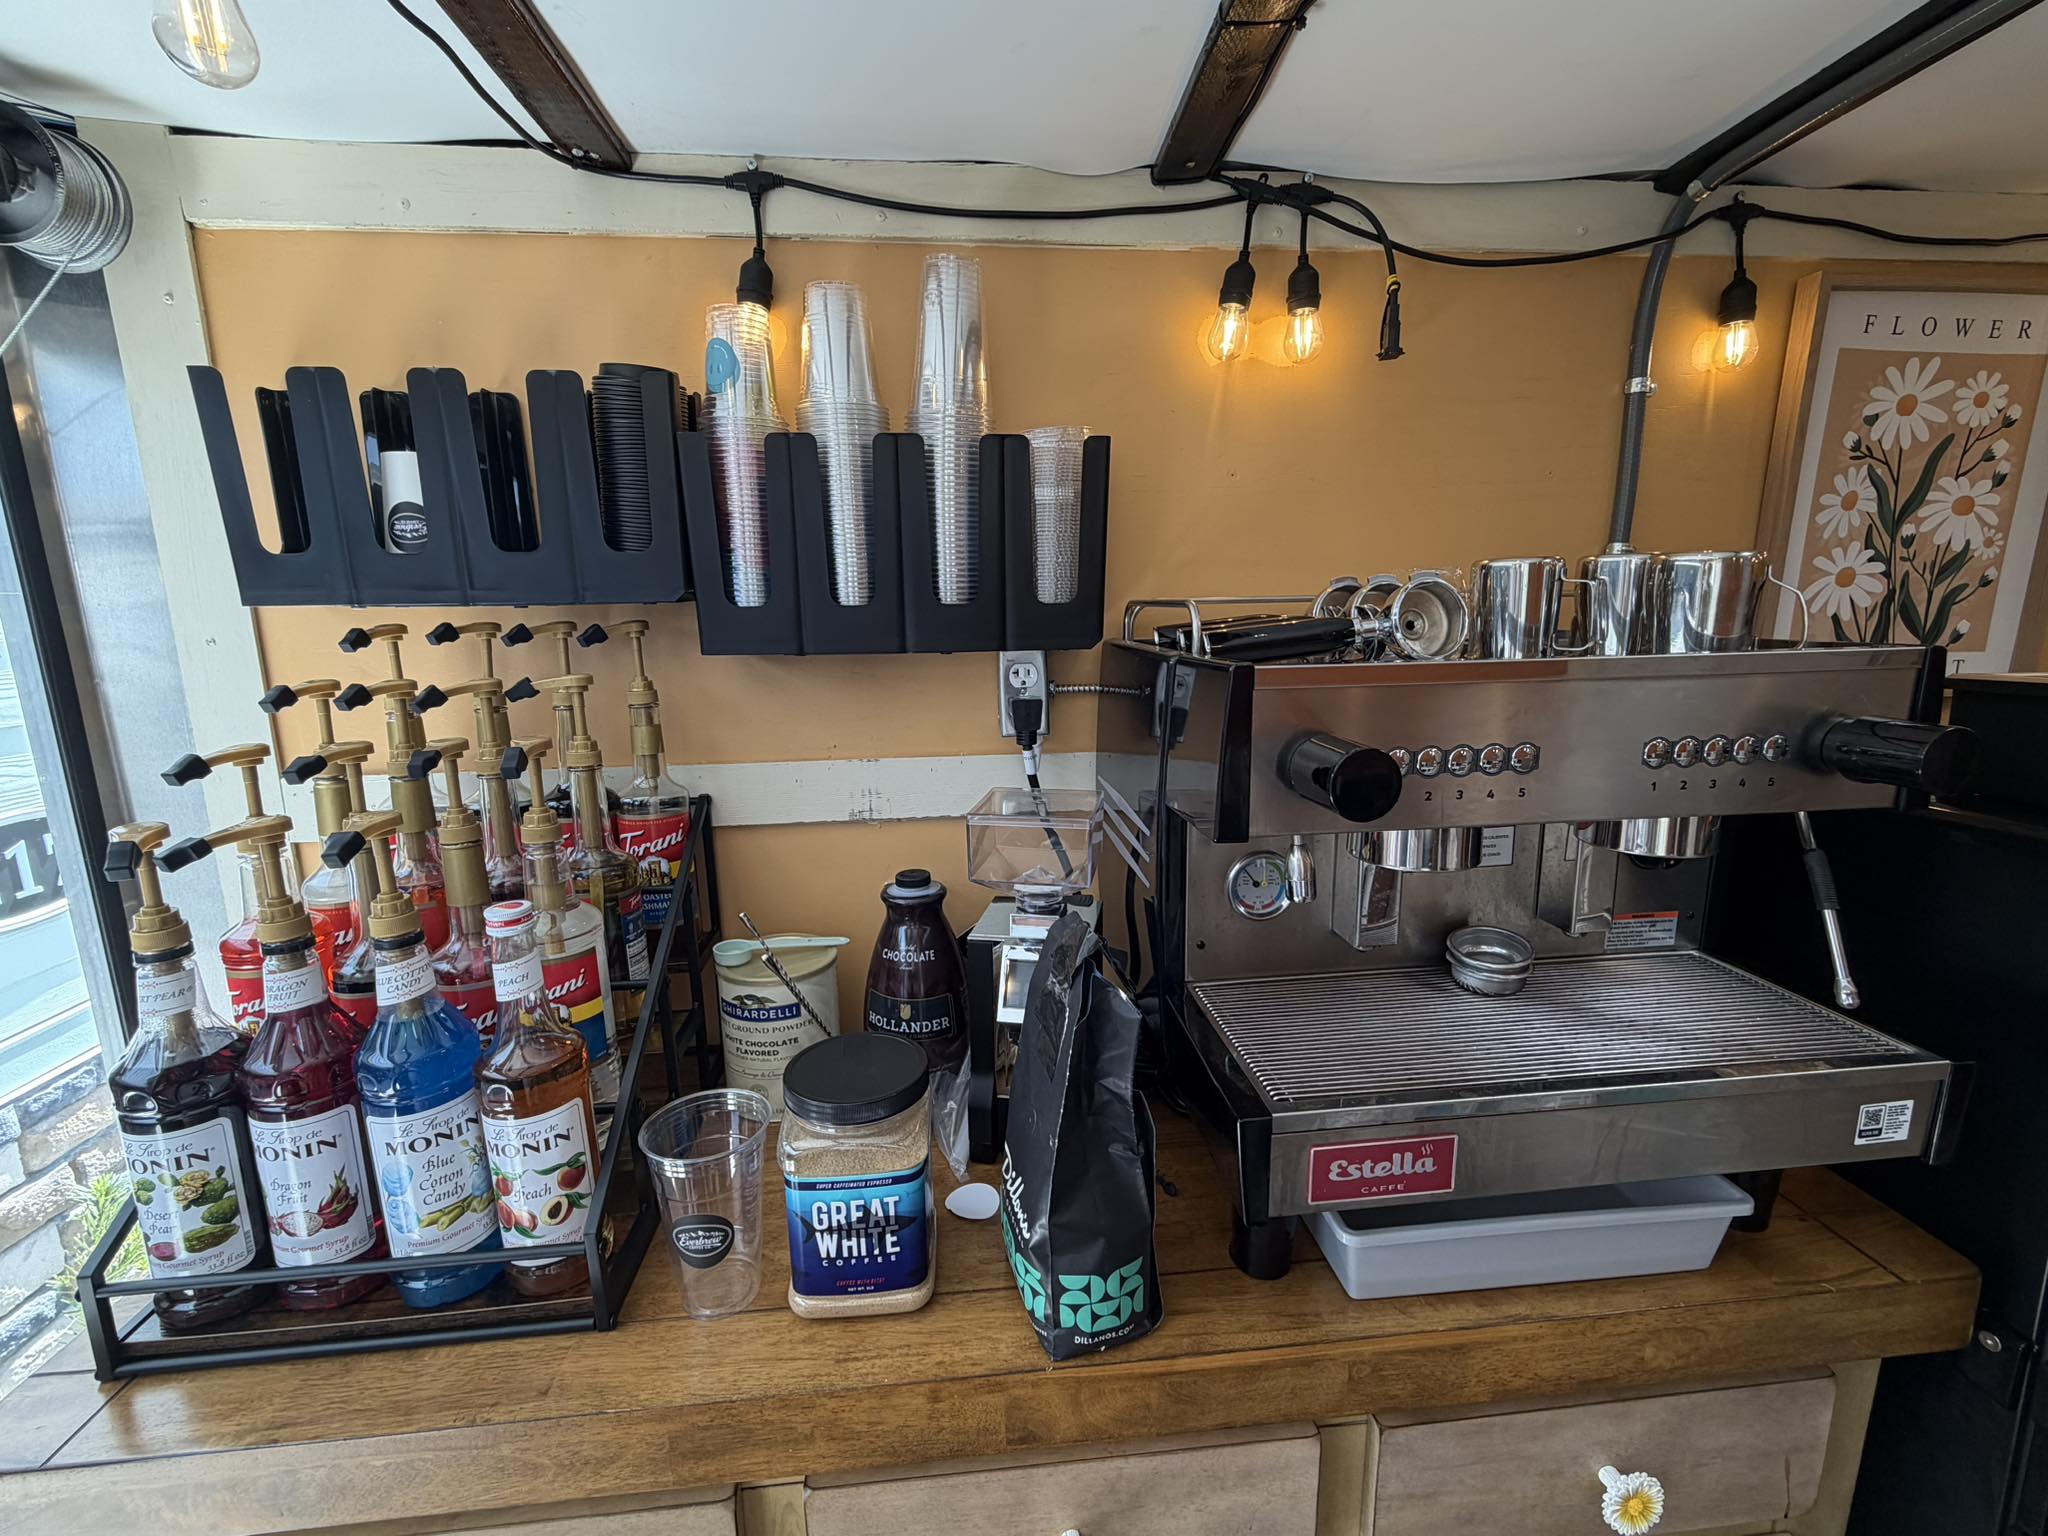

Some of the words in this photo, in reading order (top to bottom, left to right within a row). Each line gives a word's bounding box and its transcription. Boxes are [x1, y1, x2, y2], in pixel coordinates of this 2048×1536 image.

[1863, 314, 2032, 339] FLOWER
[1651, 782, 1657, 791] 1
[1680, 780, 1688, 790] 2
[1709, 779, 1717, 789] 3
[1739, 778, 1746, 787] 4
[1768, 777, 1775, 786] 5
[1424, 791, 1432, 801] 2
[1456, 790, 1463, 800] 3
[1486, 789, 1495, 799] 4
[1518, 788, 1526, 797] 5
[620, 823, 685, 856] Torani
[882, 948, 935, 962] CHOCOLATE
[387, 976, 424, 994] CANDY
[498, 972, 529, 987] PEACH
[546, 968, 587, 1000] ani
[153, 988, 185, 1001] PEAR
[269, 990, 300, 1001] FRUIT
[722, 1002, 797, 1019] GHIRARDELLI
[732, 1024, 769, 1034] GROUND
[772, 1018, 815, 1033] POWDER
[869, 1010, 950, 1033] HOLLANDER
[736, 1047, 780, 1056] FLAVORED
[745, 1037, 799, 1048] CHOCOLATE
[394, 1122, 413, 1139] Le
[418, 1116, 455, 1134] Sirop
[457, 1107, 470, 1119] de
[508, 1127, 542, 1141] Sirop
[545, 1122, 559, 1134] de
[267, 1130, 302, 1144] Sirop
[306, 1130, 322, 1140] de
[385, 1112, 480, 1156] MONIN
[487, 1127, 571, 1158] MONIN
[136, 1143, 172, 1158] Sirop
[175, 1142, 193, 1153] de
[127, 1148, 211, 1174] ONIN
[422, 1153, 456, 1173] Blue
[1328, 1152, 1437, 1181] Estella
[270, 1177, 312, 1195] Dragon
[419, 1167, 463, 1191] Cotton
[833, 1181, 866, 1189] CAFFEINATED
[866, 1178, 892, 1187] ESPRESSO
[277, 1192, 308, 1206] Fruit
[423, 1182, 466, 1206] Candy
[514, 1184, 552, 1203] Peach
[144, 1207, 178, 1222] Desert
[811, 1195, 900, 1230] GREAT
[149, 1223, 176, 1236] Pear
[408, 1238, 440, 1248] Premium
[441, 1222, 475, 1241] Gourmet
[291, 1243, 324, 1254] Gourmet
[325, 1235, 349, 1250] Syrup
[815, 1225, 901, 1258] WHITE
[162, 1259, 196, 1269] Gourmet
[199, 1251, 225, 1266] Syrup
[822, 1254, 896, 1267] COFFEE
